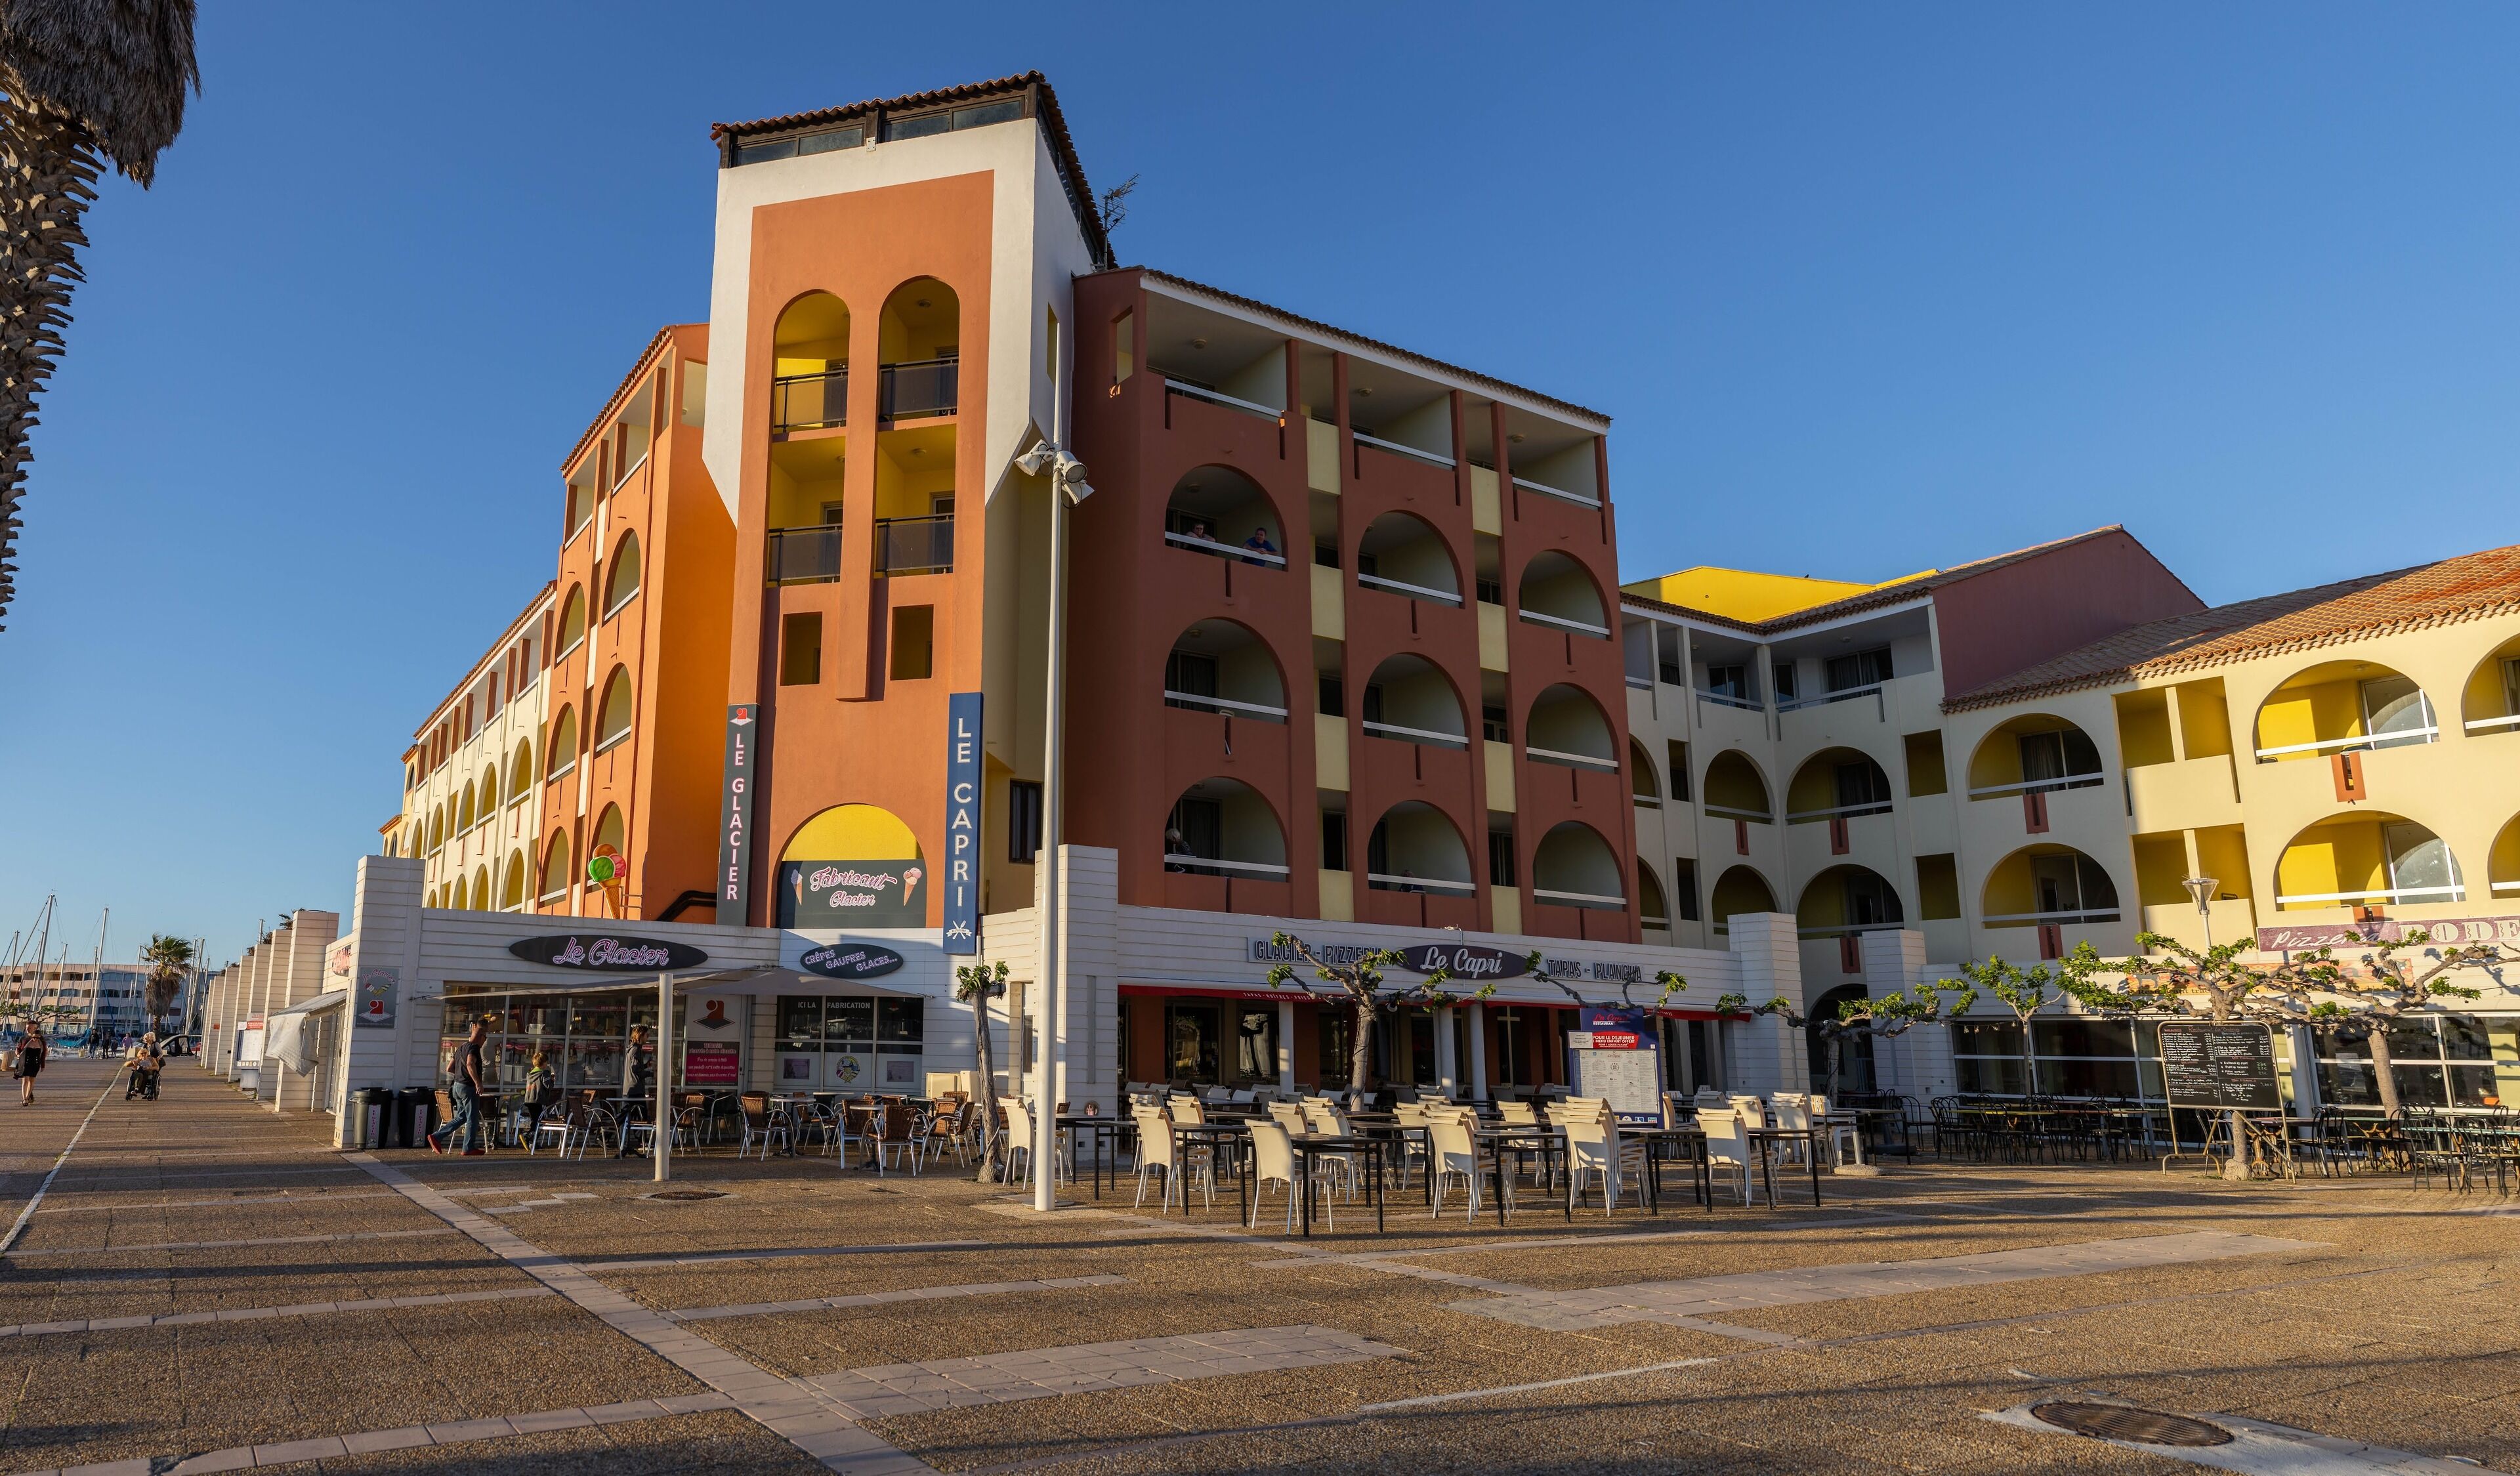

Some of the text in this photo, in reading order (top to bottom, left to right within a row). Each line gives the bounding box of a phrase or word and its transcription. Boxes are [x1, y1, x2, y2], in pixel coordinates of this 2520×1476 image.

[734, 733, 745, 766] LE
[952, 718, 973, 907] LE CAPRI
[726, 778, 745, 900] GLACIER
[810, 866, 897, 891] Fabricant
[830, 891, 876, 908] Glacier
[553, 937, 669, 966] Le Glacier
[805, 950, 836, 965] CRÊPES
[826, 952, 866, 969] GAUFRES
[1419, 946, 1502, 979] Le Capri
[362, 968, 396, 984] Le Glacier
[1547, 959, 1582, 978] TAPAS
[1595, 963, 1643, 982] PLANCHA
